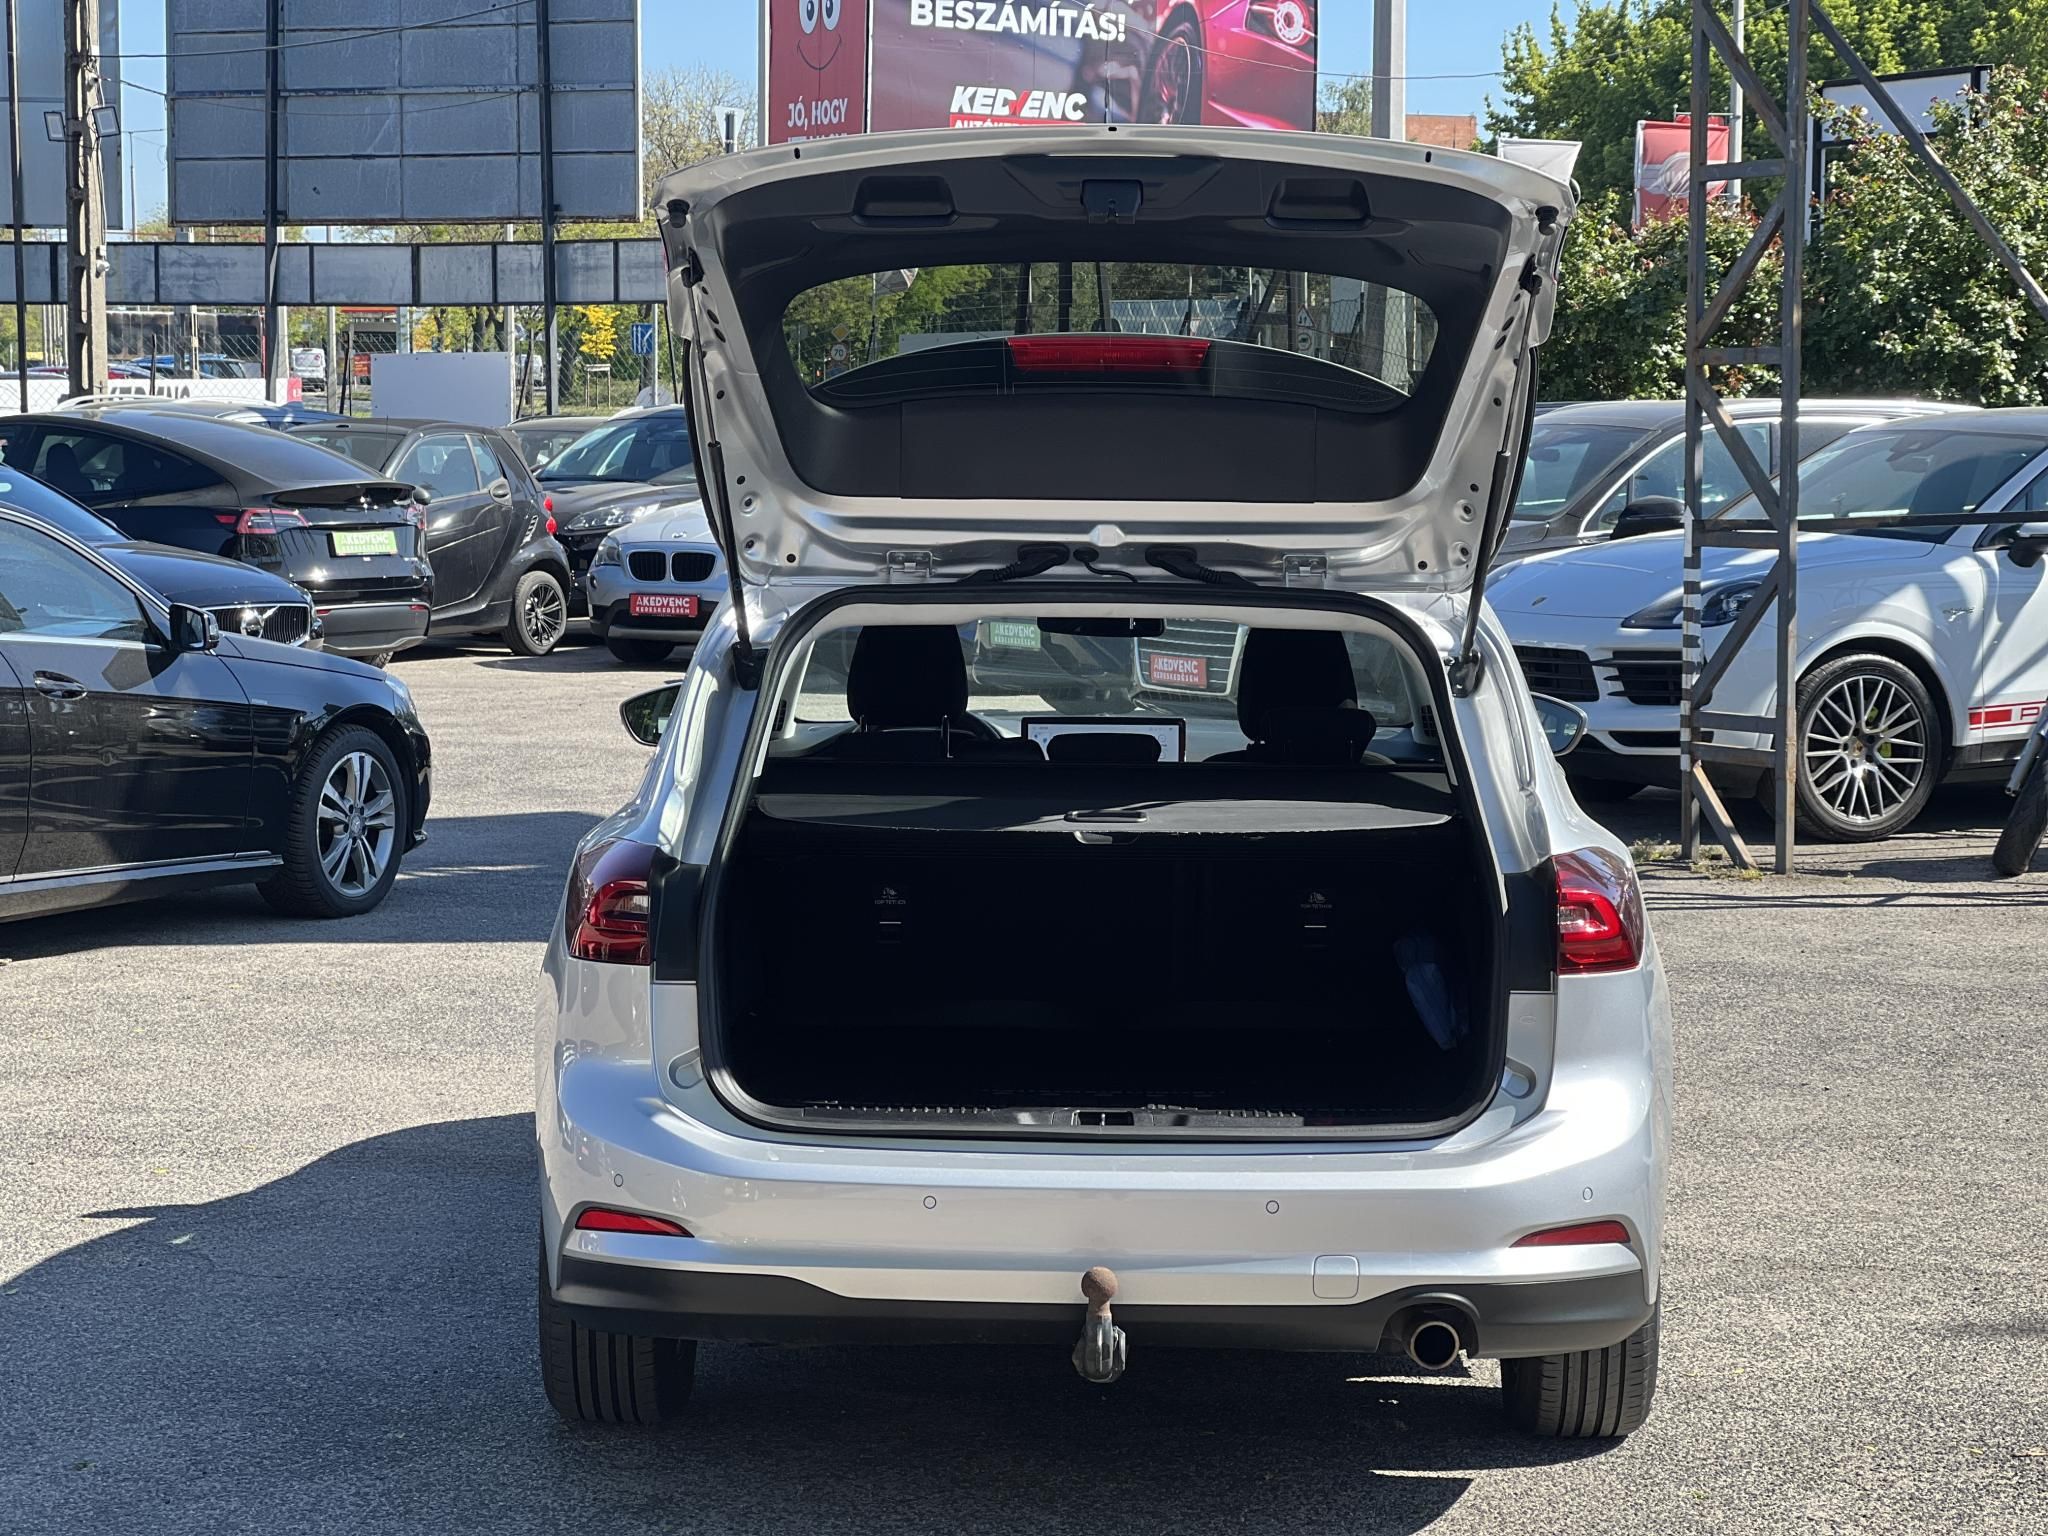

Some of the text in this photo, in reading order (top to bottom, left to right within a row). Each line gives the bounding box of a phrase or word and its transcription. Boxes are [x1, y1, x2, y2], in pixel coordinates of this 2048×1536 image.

[911, 0, 1126, 42] BESZÁMÍTÁS!
[788, 96, 848, 131] JÓ, HOGY
[950, 86, 1087, 120] KEDVENC
[834, 349, 844, 357] 70
